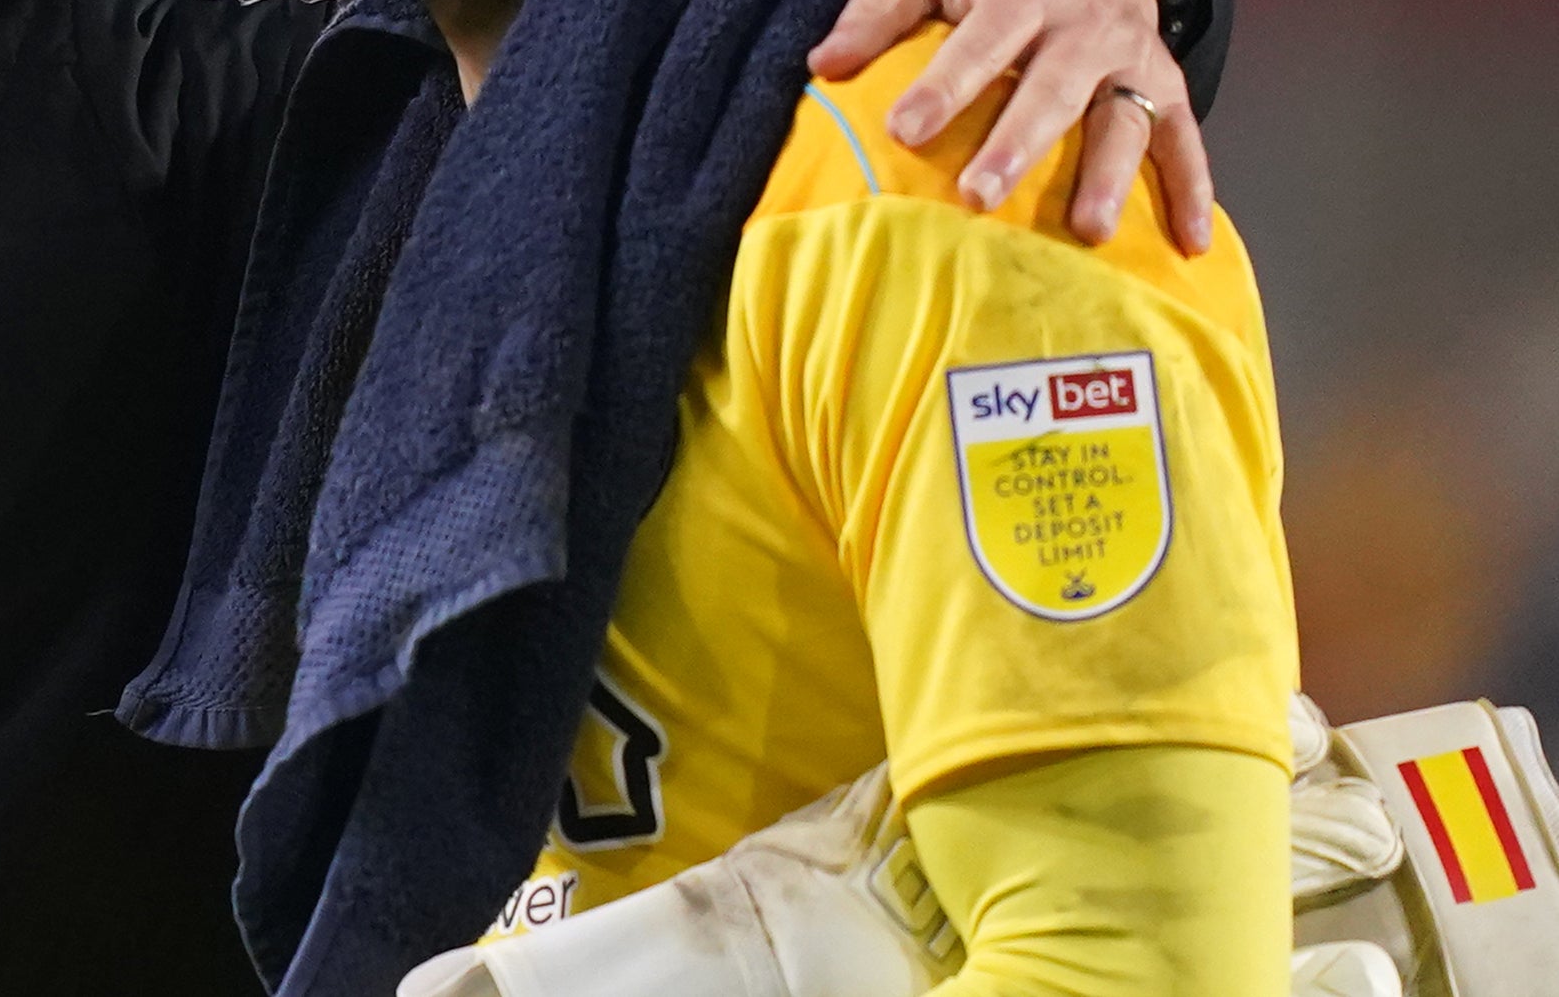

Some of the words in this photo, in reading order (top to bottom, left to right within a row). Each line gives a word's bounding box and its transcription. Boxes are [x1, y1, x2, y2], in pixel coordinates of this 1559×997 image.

[971, 384, 1039, 422] sky
[1055, 375, 1130, 411] bet
[1012, 445, 1069, 470] STAY
[1081, 443, 1109, 463] IN
[1034, 493, 1074, 516] SET
[1085, 494, 1102, 509] A
[1014, 511, 1124, 544] DEPOSIT
[1038, 541, 1106, 566] LIMIT
